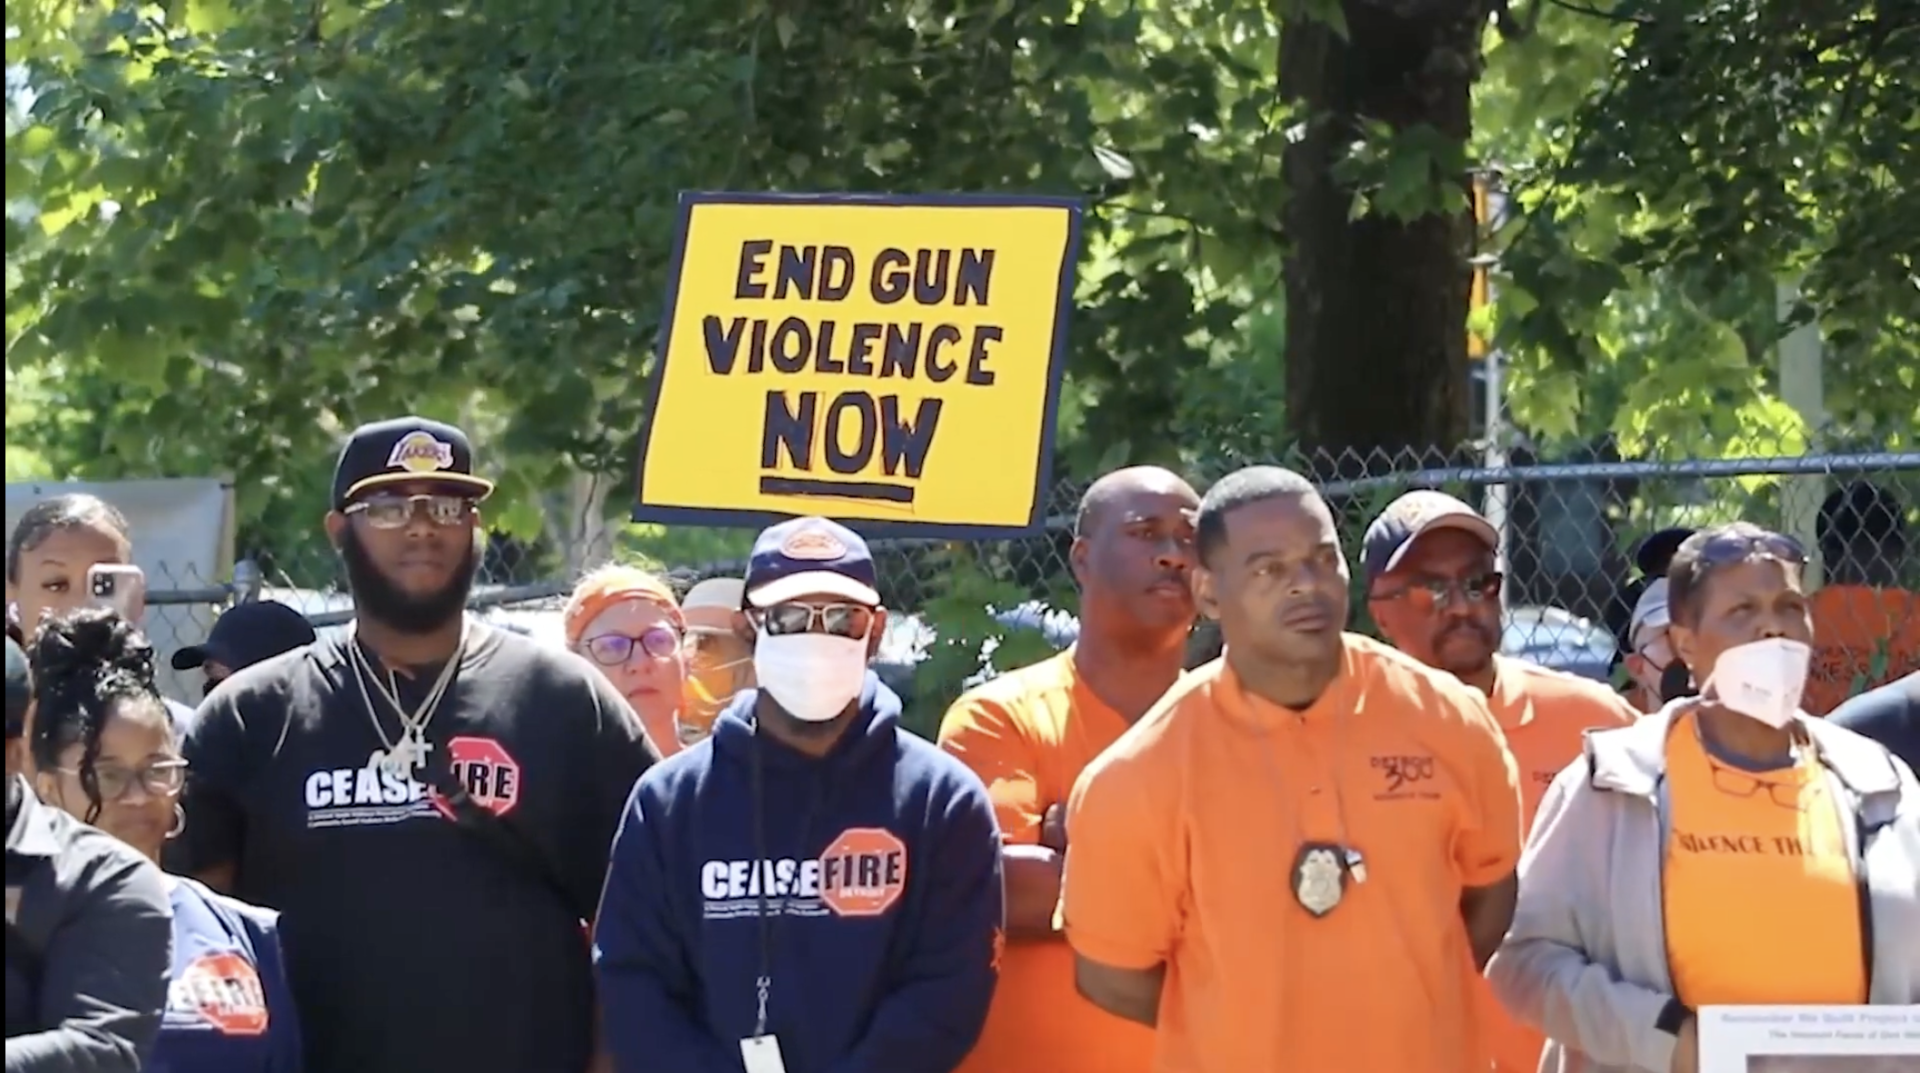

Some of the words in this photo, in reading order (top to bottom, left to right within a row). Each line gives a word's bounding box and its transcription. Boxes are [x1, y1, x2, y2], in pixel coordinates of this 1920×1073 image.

[734, 239, 854, 301] END
[870, 248, 995, 306] GUN
[702, 315, 1004, 385] VIOLENCE
[760, 390, 943, 480] NOW
[701, 858, 820, 900] CEASE
[824, 852, 901, 890] FIRE
